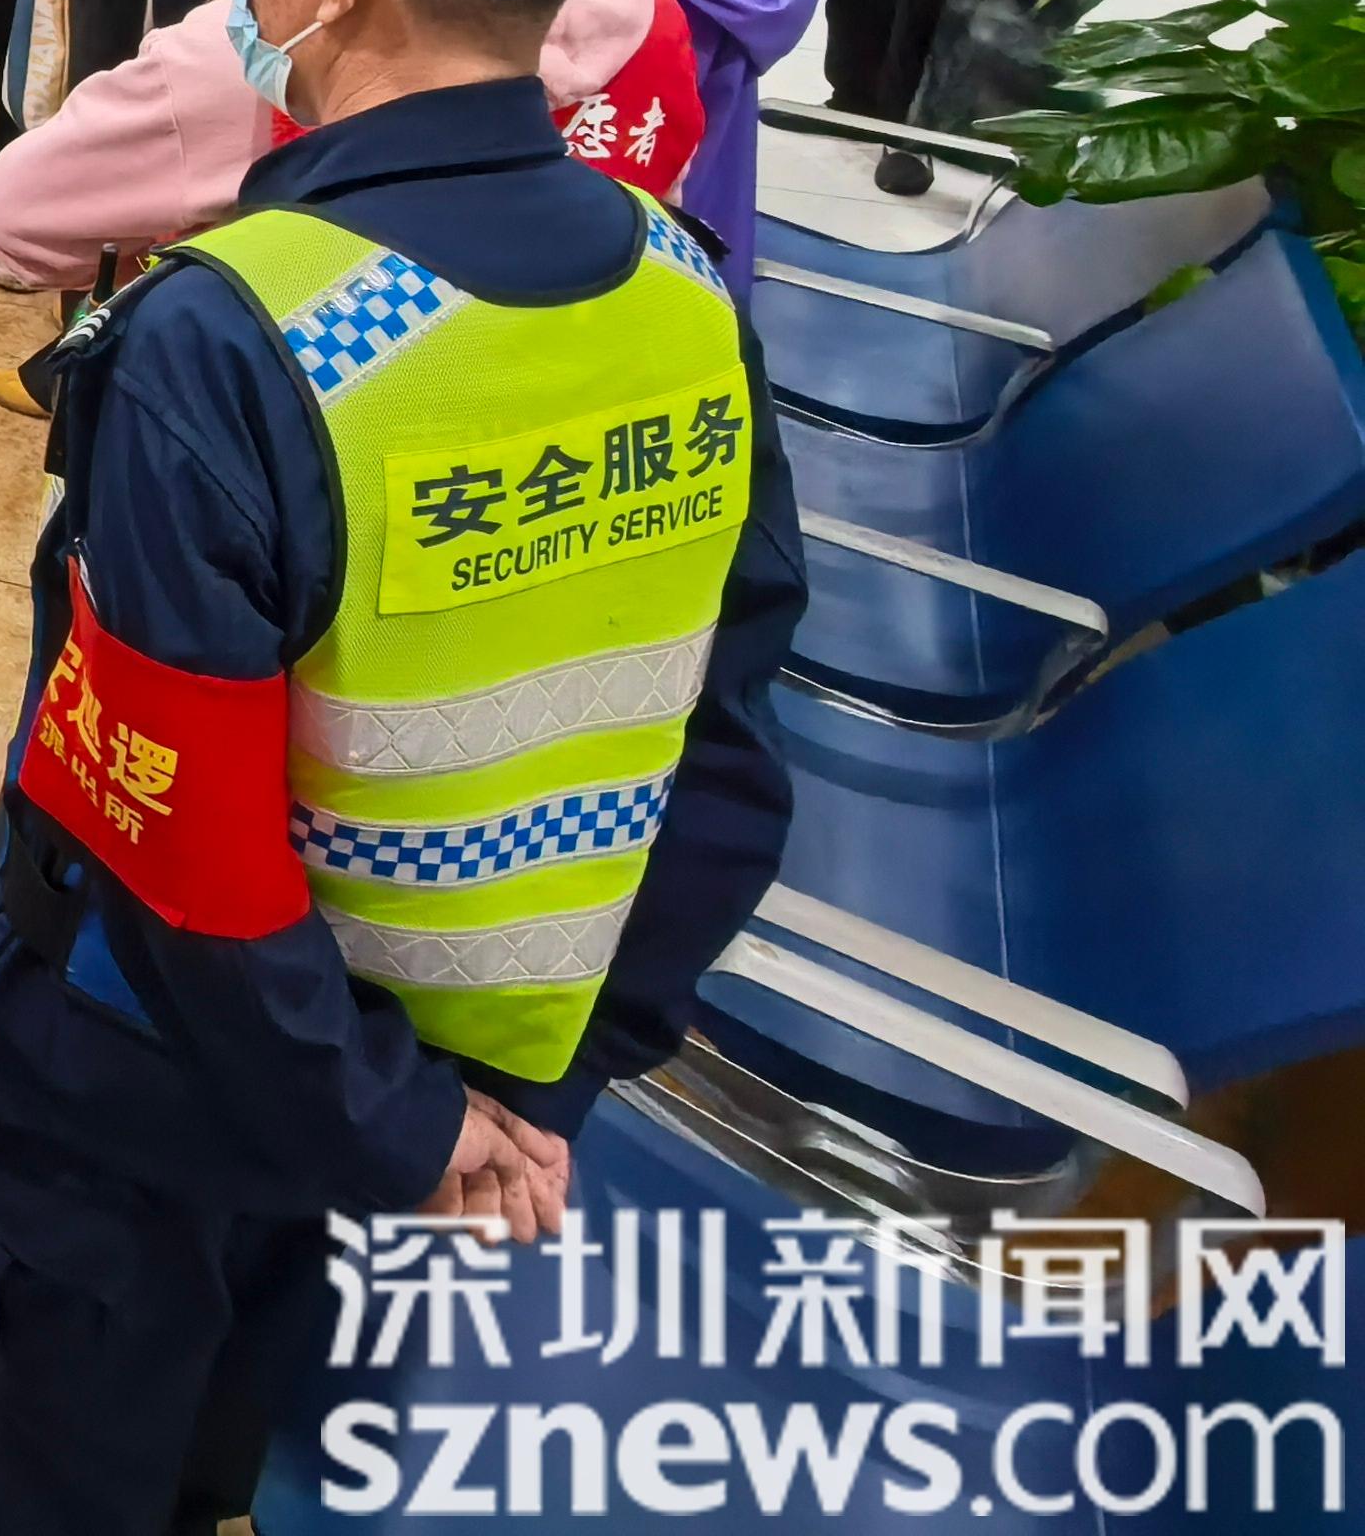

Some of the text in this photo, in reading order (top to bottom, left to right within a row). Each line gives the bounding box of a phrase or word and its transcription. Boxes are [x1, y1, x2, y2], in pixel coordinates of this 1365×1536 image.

[561, 93, 666, 167] 愿者
[410, 393, 745, 549] 安全服务
[451, 485, 723, 592] SECURITY SERVICE
